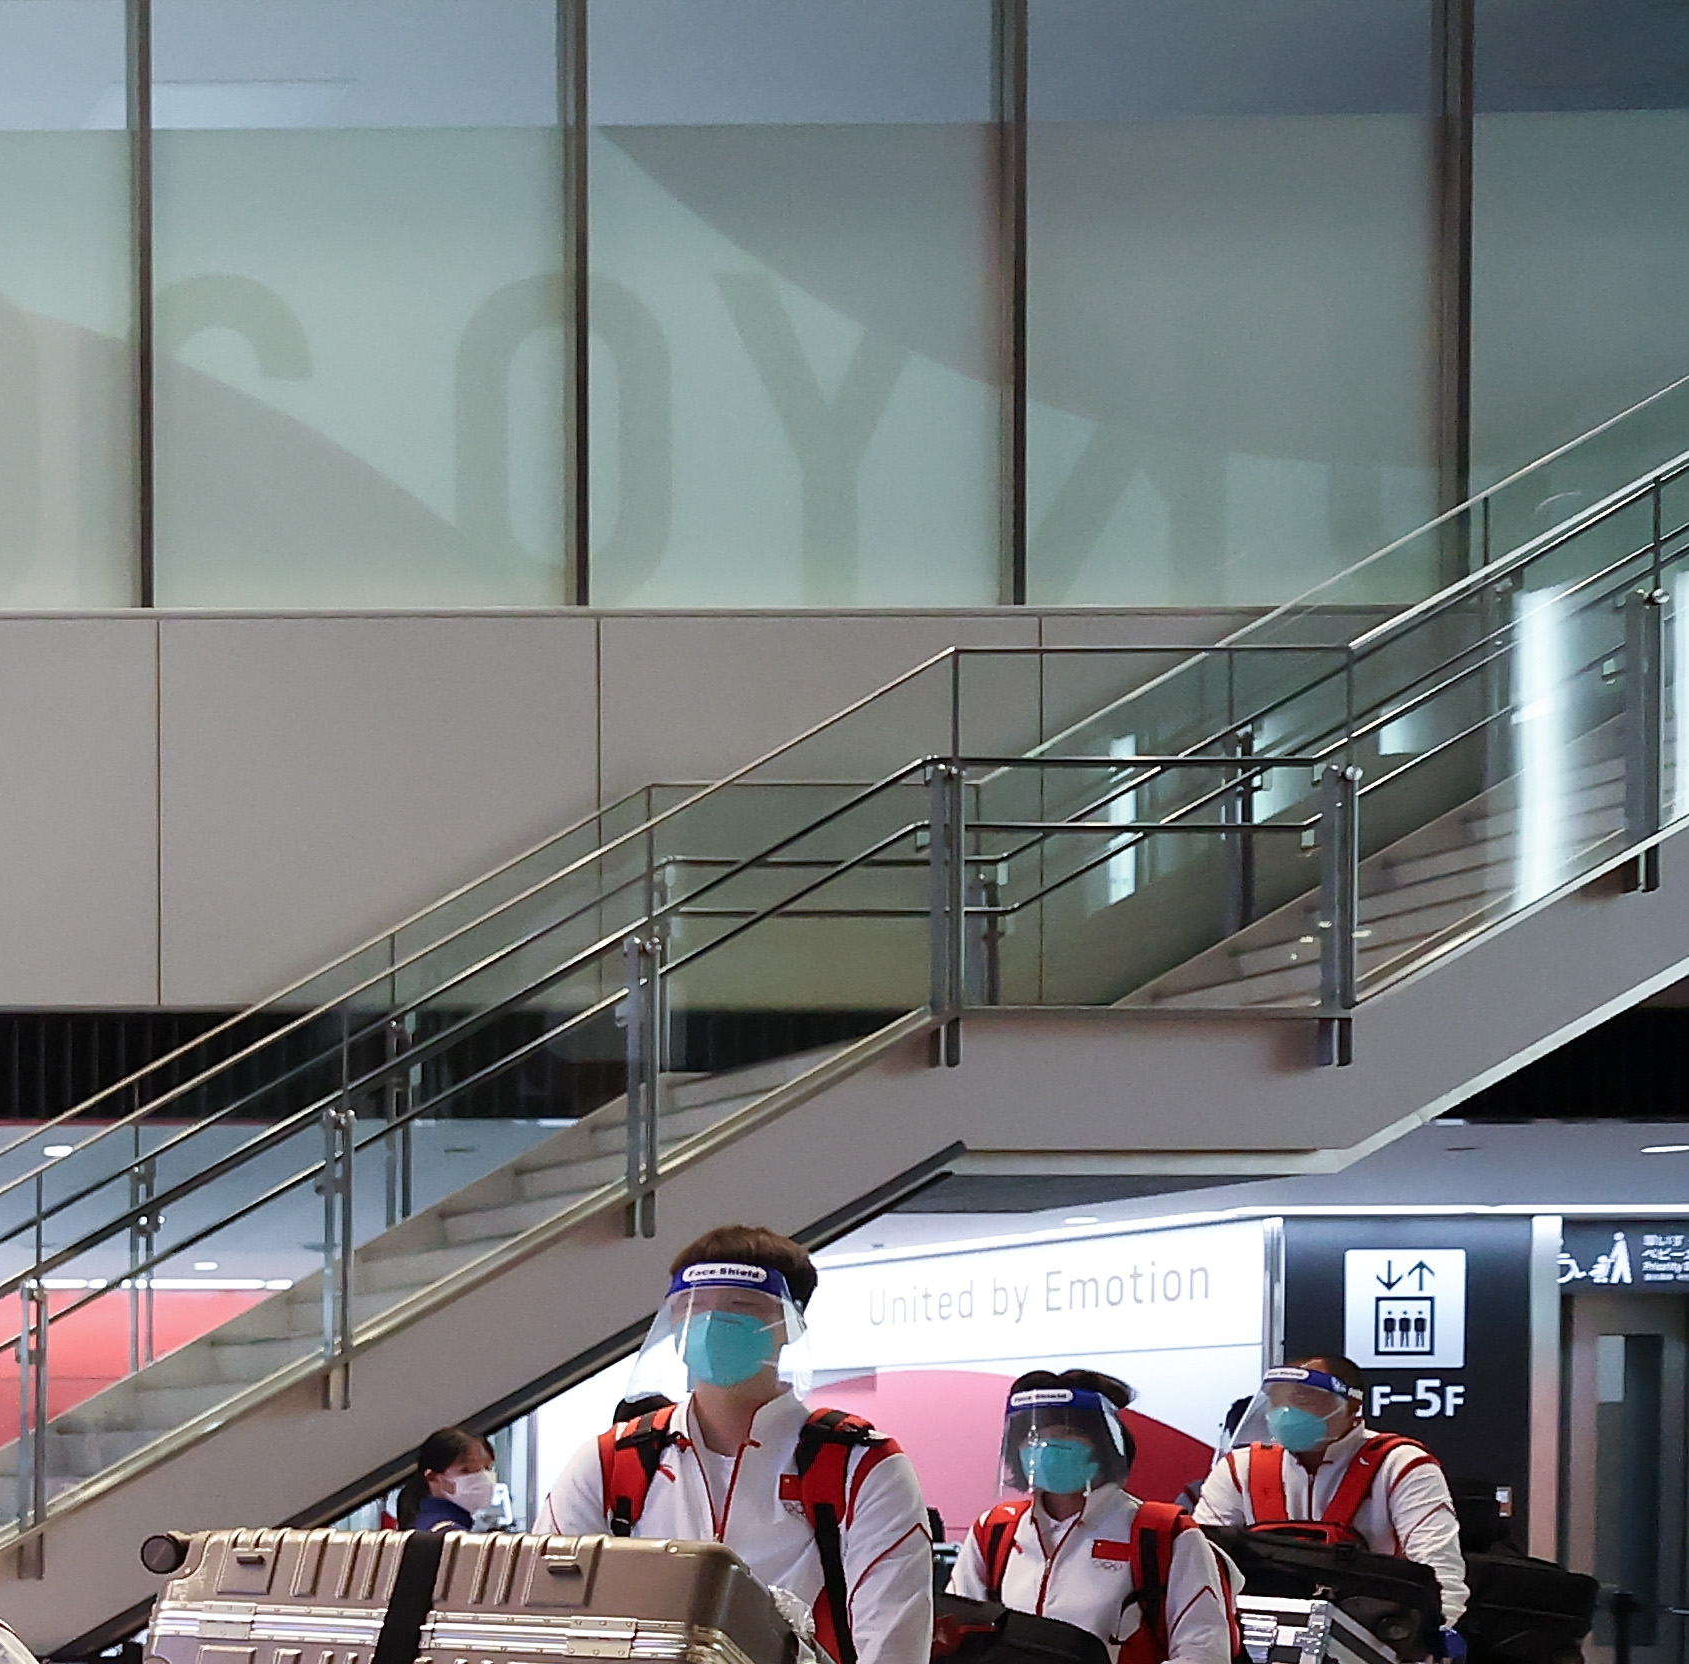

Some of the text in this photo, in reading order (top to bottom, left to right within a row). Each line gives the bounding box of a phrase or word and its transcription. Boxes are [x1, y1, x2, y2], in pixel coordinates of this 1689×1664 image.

[688, 1267, 760, 1279] Face Shield
[869, 1260, 1210, 1326] United by Emotion
[1355, 1378, 1467, 1418] F-5F
